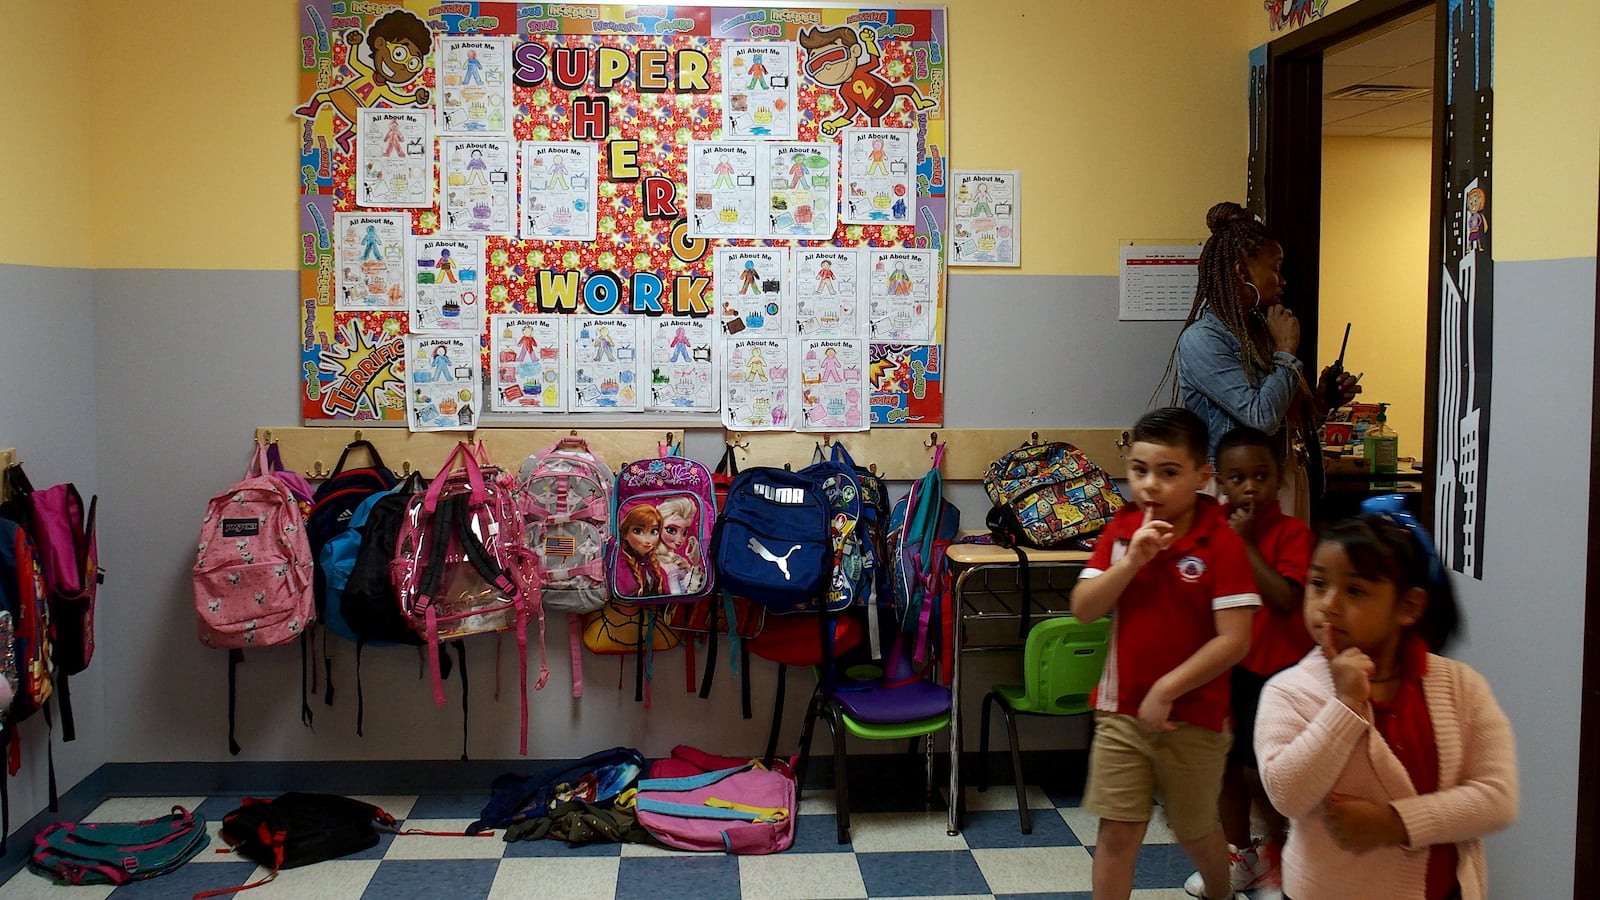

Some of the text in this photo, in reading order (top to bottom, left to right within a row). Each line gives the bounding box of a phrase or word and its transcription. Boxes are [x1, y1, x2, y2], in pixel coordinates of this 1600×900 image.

[528, 20, 558, 32] STAR
[752, 25, 780, 37] STAR
[515, 42, 711, 91] SUPER
[852, 80, 874, 101] 2
[304, 235, 316, 263] STAR
[538, 269, 710, 314] WORK
[327, 340, 405, 411] TERRIFIC
[753, 483, 805, 504] PUMA
